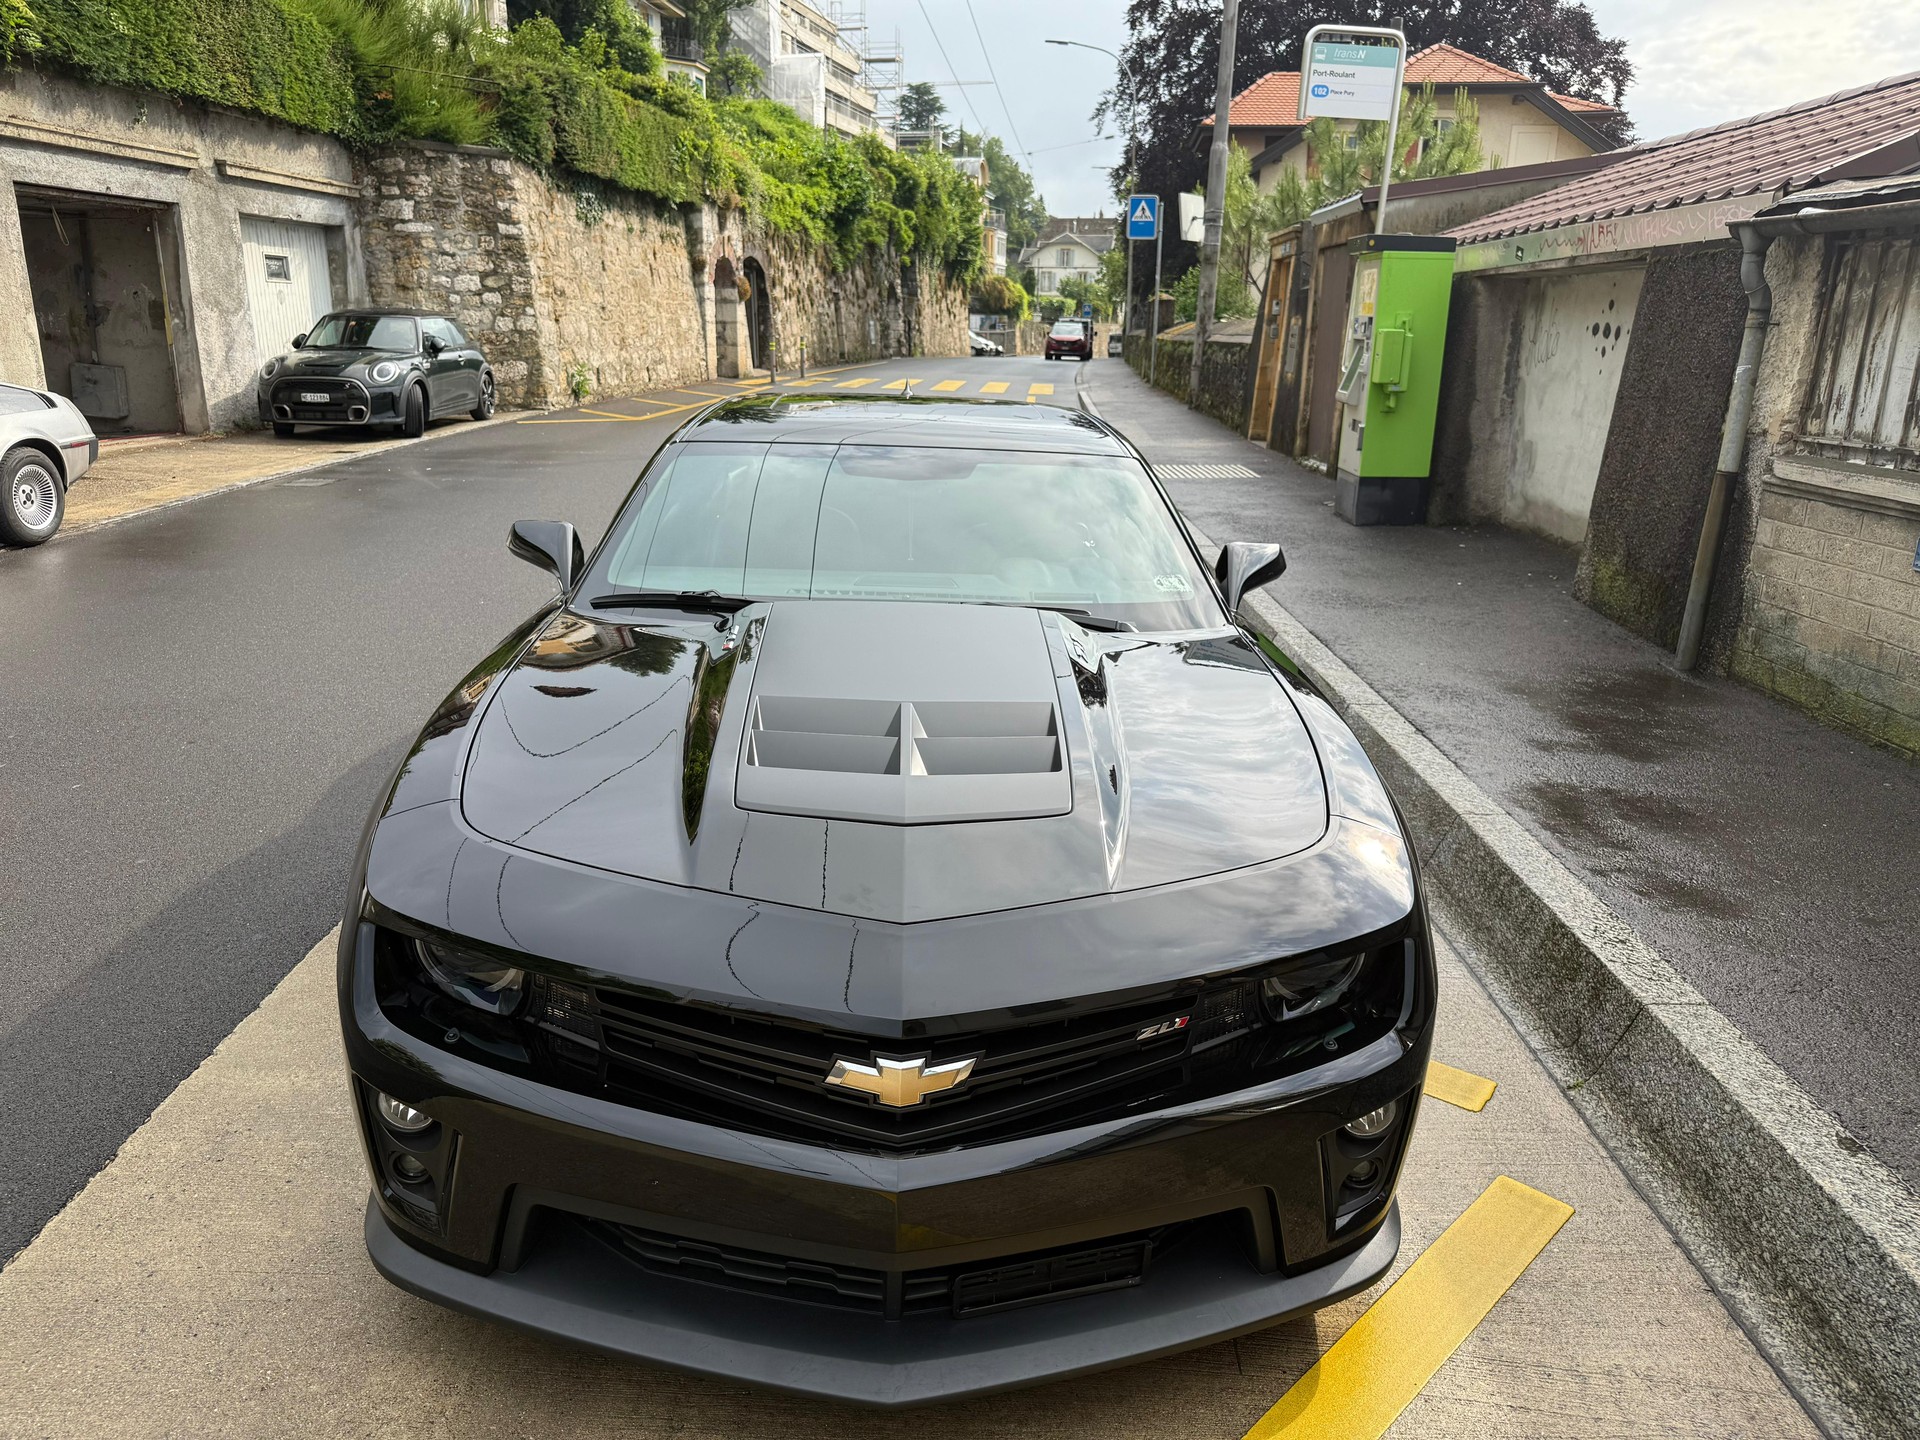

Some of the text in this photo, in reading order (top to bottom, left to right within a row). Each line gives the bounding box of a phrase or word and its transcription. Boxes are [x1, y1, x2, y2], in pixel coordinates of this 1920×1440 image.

[1313, 69, 1355, 79] Port-Roulant
[1314, 86, 1328, 95] 102
[1137, 1016, 1190, 1041] ZL1
